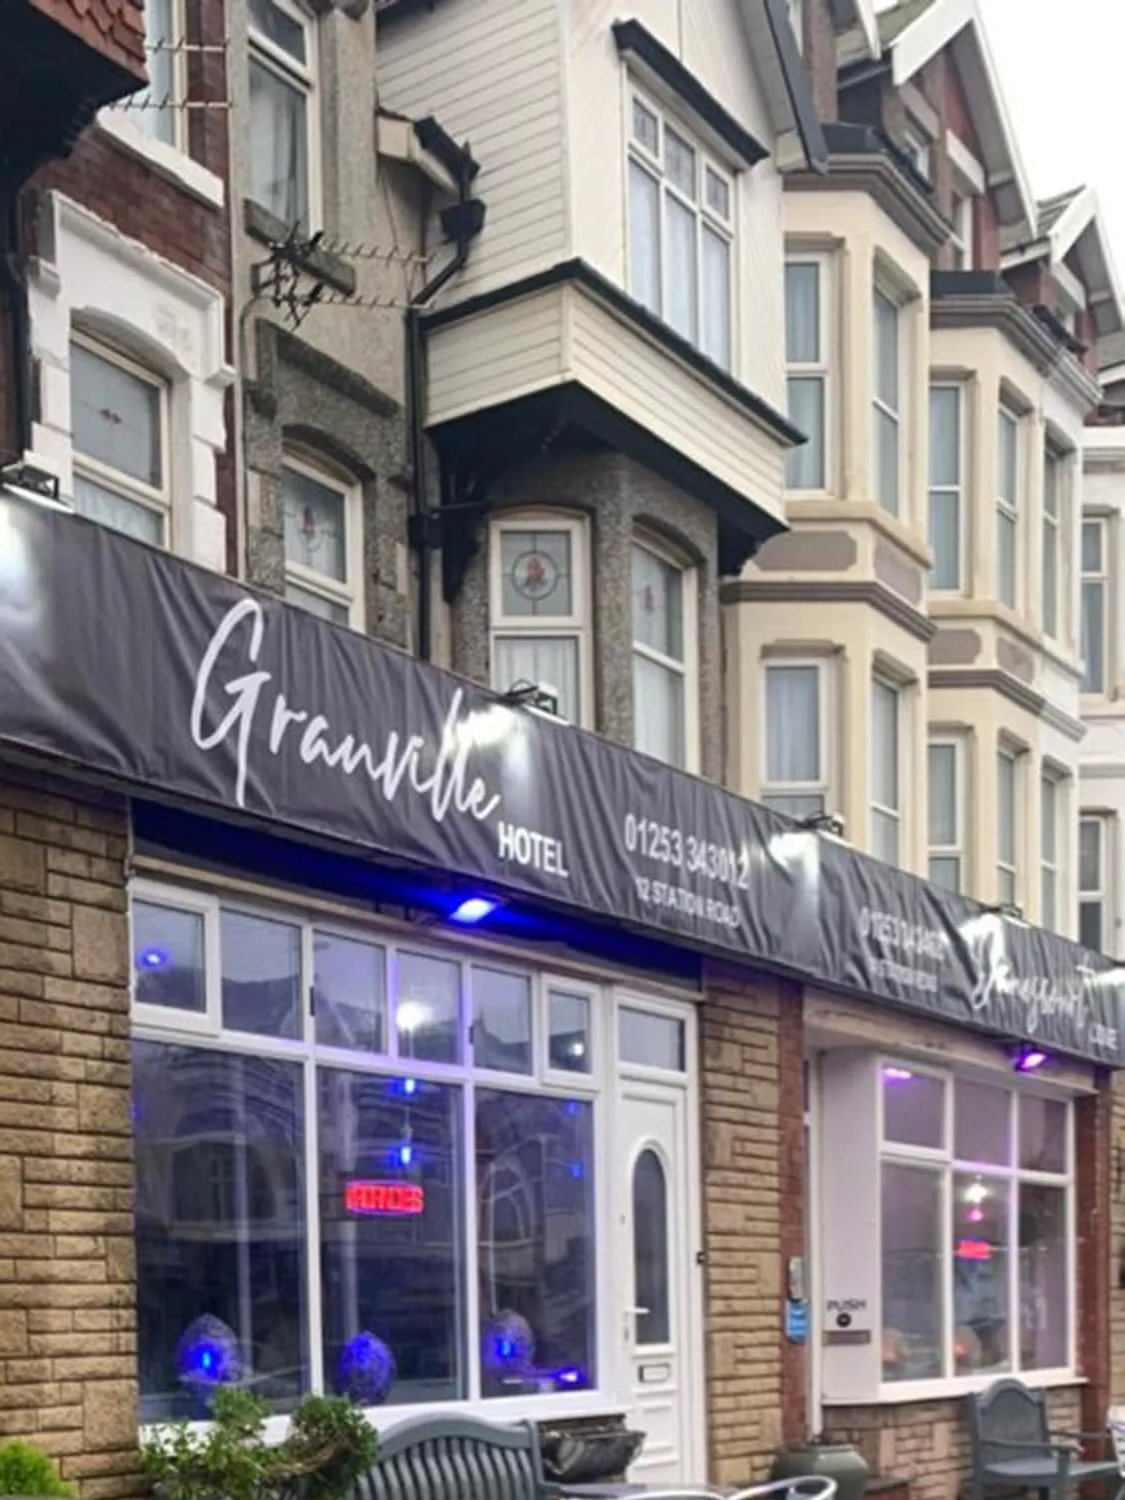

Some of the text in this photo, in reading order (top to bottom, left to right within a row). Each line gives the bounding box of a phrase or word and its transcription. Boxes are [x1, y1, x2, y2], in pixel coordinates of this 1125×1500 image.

[190, 597, 502, 822] Granville
[497, 820, 569, 878] HOTEL
[625, 812, 750, 889] 01253 343012
